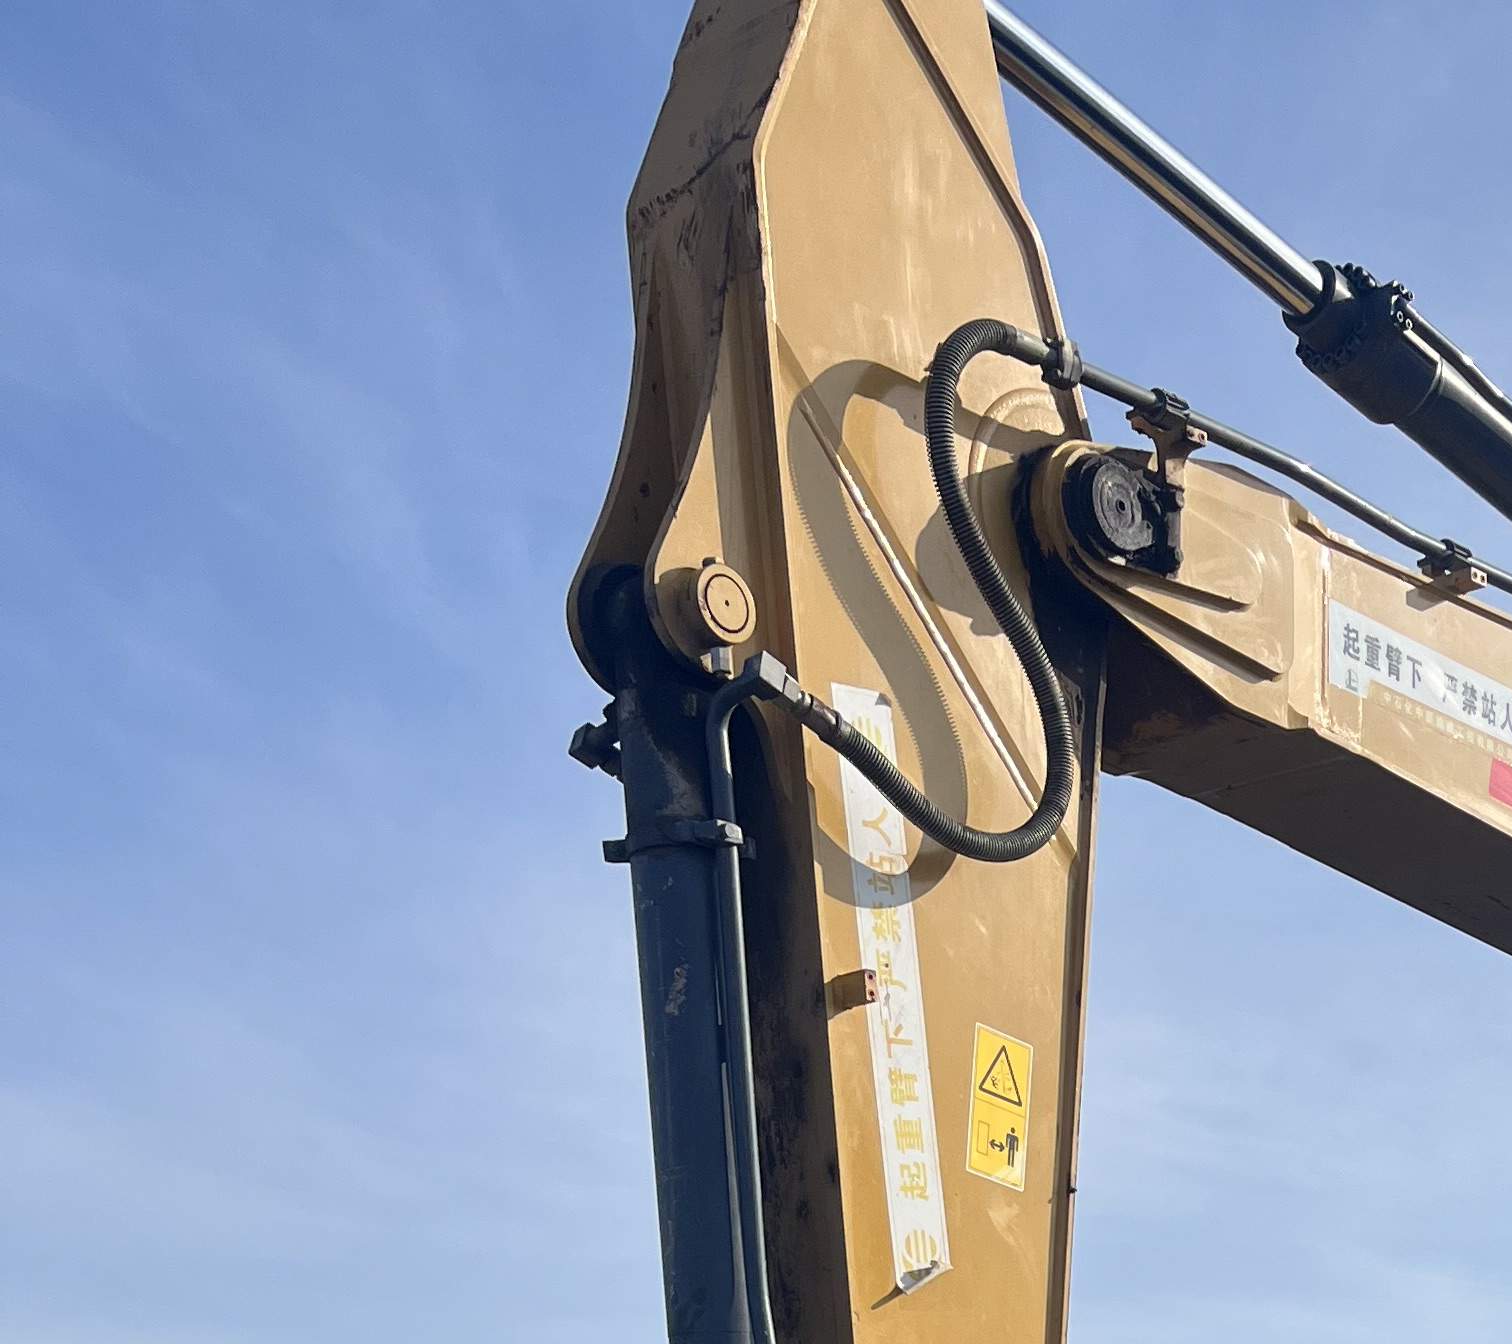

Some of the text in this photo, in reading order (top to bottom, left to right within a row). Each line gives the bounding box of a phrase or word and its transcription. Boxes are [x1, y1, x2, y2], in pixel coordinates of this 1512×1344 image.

[1342, 622, 1423, 689] 起重臂下
[861, 806, 930, 1202] 起重臂下 严禁站人
